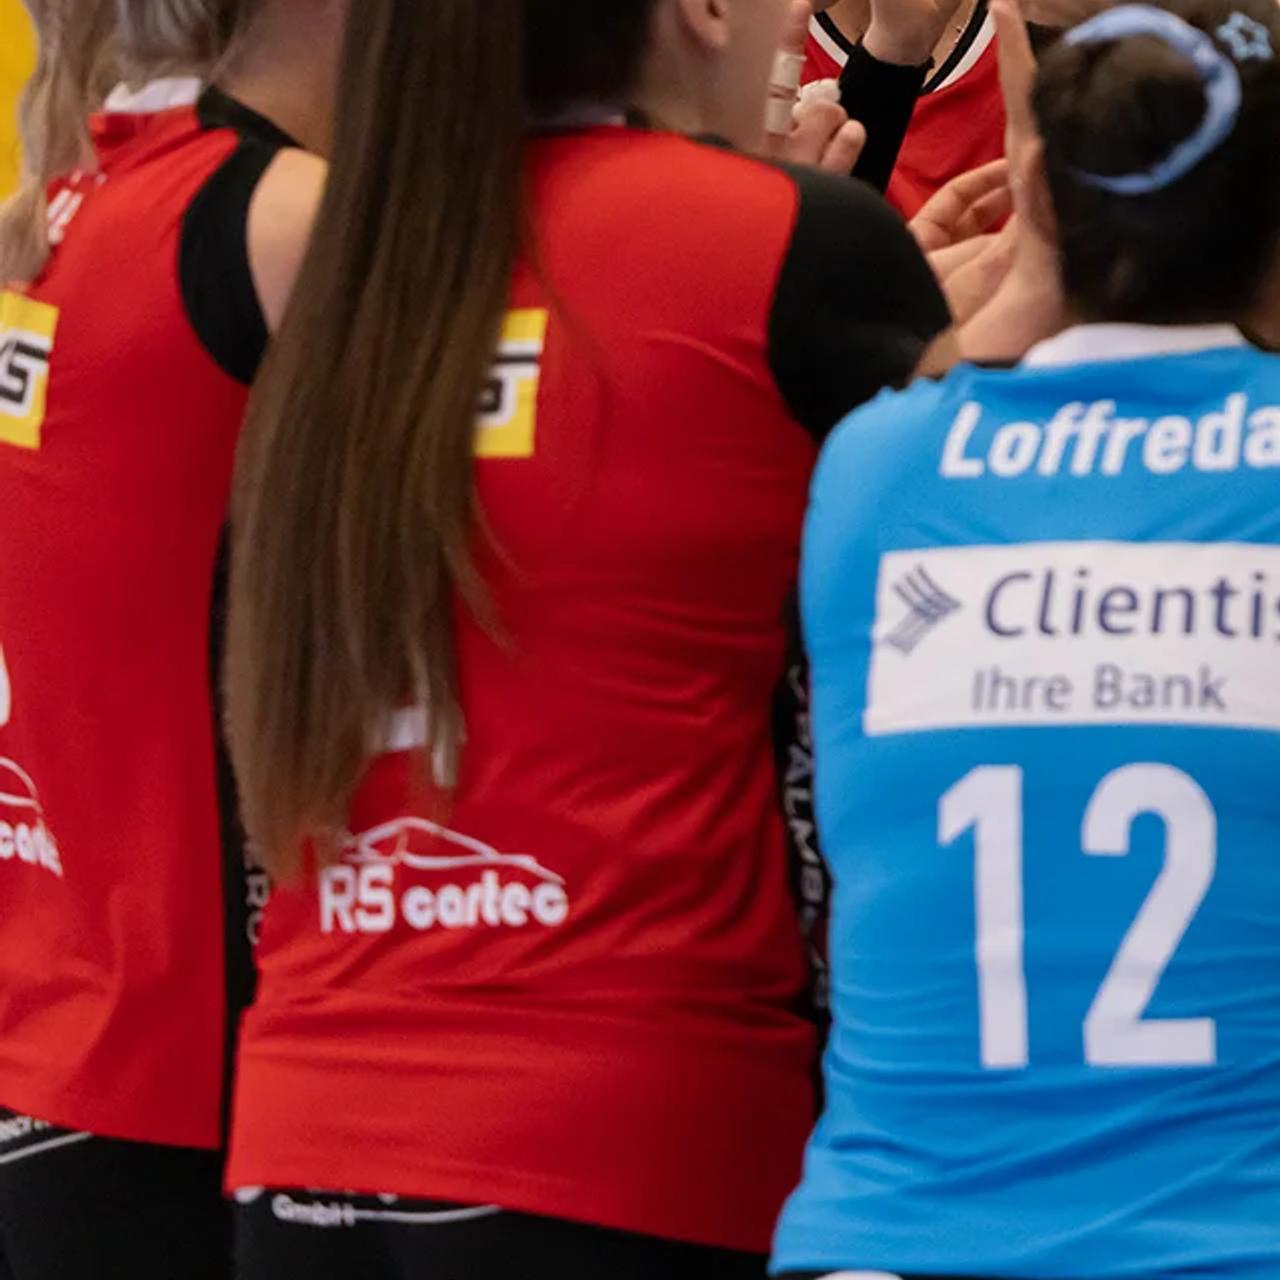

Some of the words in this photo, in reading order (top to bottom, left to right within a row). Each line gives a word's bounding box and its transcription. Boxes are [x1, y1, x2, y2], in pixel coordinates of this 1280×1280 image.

[971, 670, 1073, 712] Ihre
[1094, 665, 1228, 712] Bank
[320, 865, 395, 933] RS
[402, 870, 568, 930] cartec
[937, 762, 1218, 1069] 12
